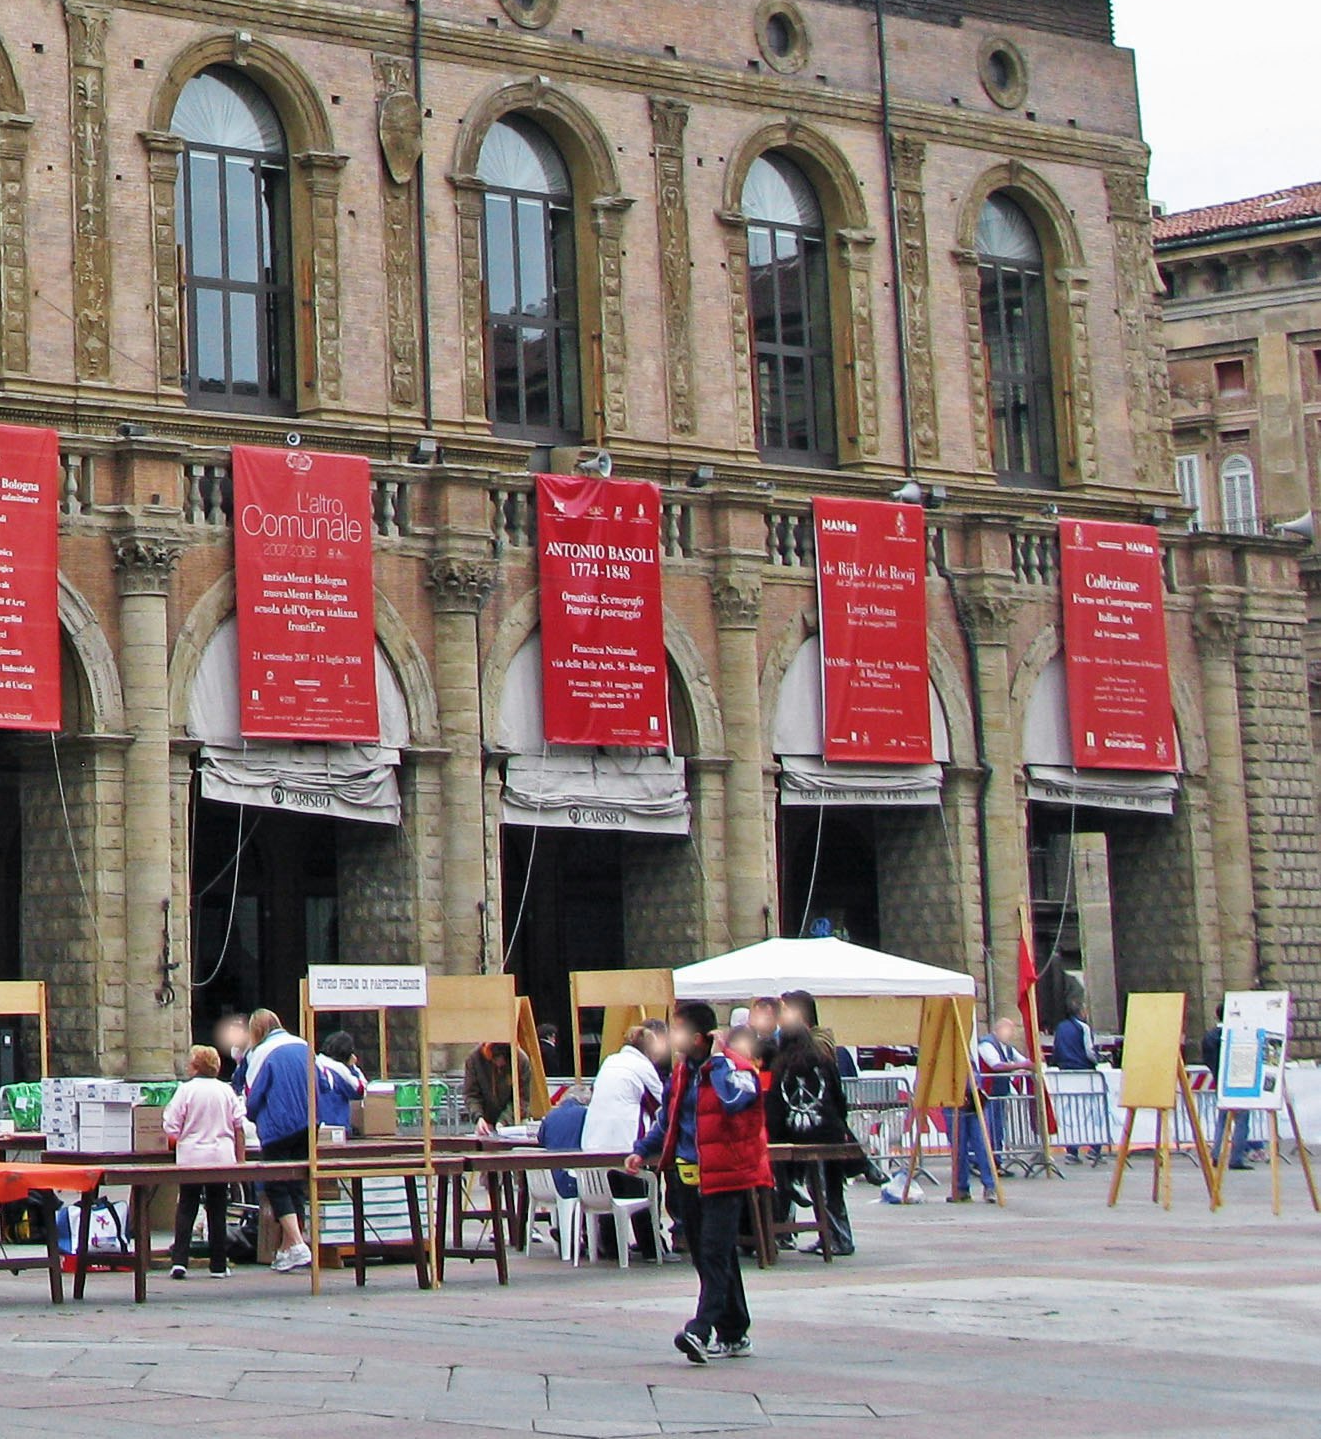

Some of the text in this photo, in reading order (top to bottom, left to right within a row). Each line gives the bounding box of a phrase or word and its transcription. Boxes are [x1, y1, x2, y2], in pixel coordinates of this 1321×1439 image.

[1, 479, 39, 492] Bologna
[297, 492, 343, 515] L'altro
[242, 505, 362, 543] Comunale
[822, 519, 857, 532] MAMbo
[546, 542, 654, 563] ANTONIO BASOLI
[823, 561, 835, 574] de
[838, 562, 865, 579] Rijke
[876, 565, 887, 578] de
[890, 566, 915, 584] Rooij
[314, 575, 347, 587] Bologna
[1085, 573, 1139, 592] Collezione
[315, 591, 347, 603] Bologna
[600, 594, 644, 607] Scenografo
[255, 604, 358, 618] scuola dell'Opera italiana
[846, 602, 868, 616] Luigi
[1097, 612, 1133, 624] Italian Art
[286, 792, 330, 809] CARISBO
[583, 810, 626, 824] CARISBO
